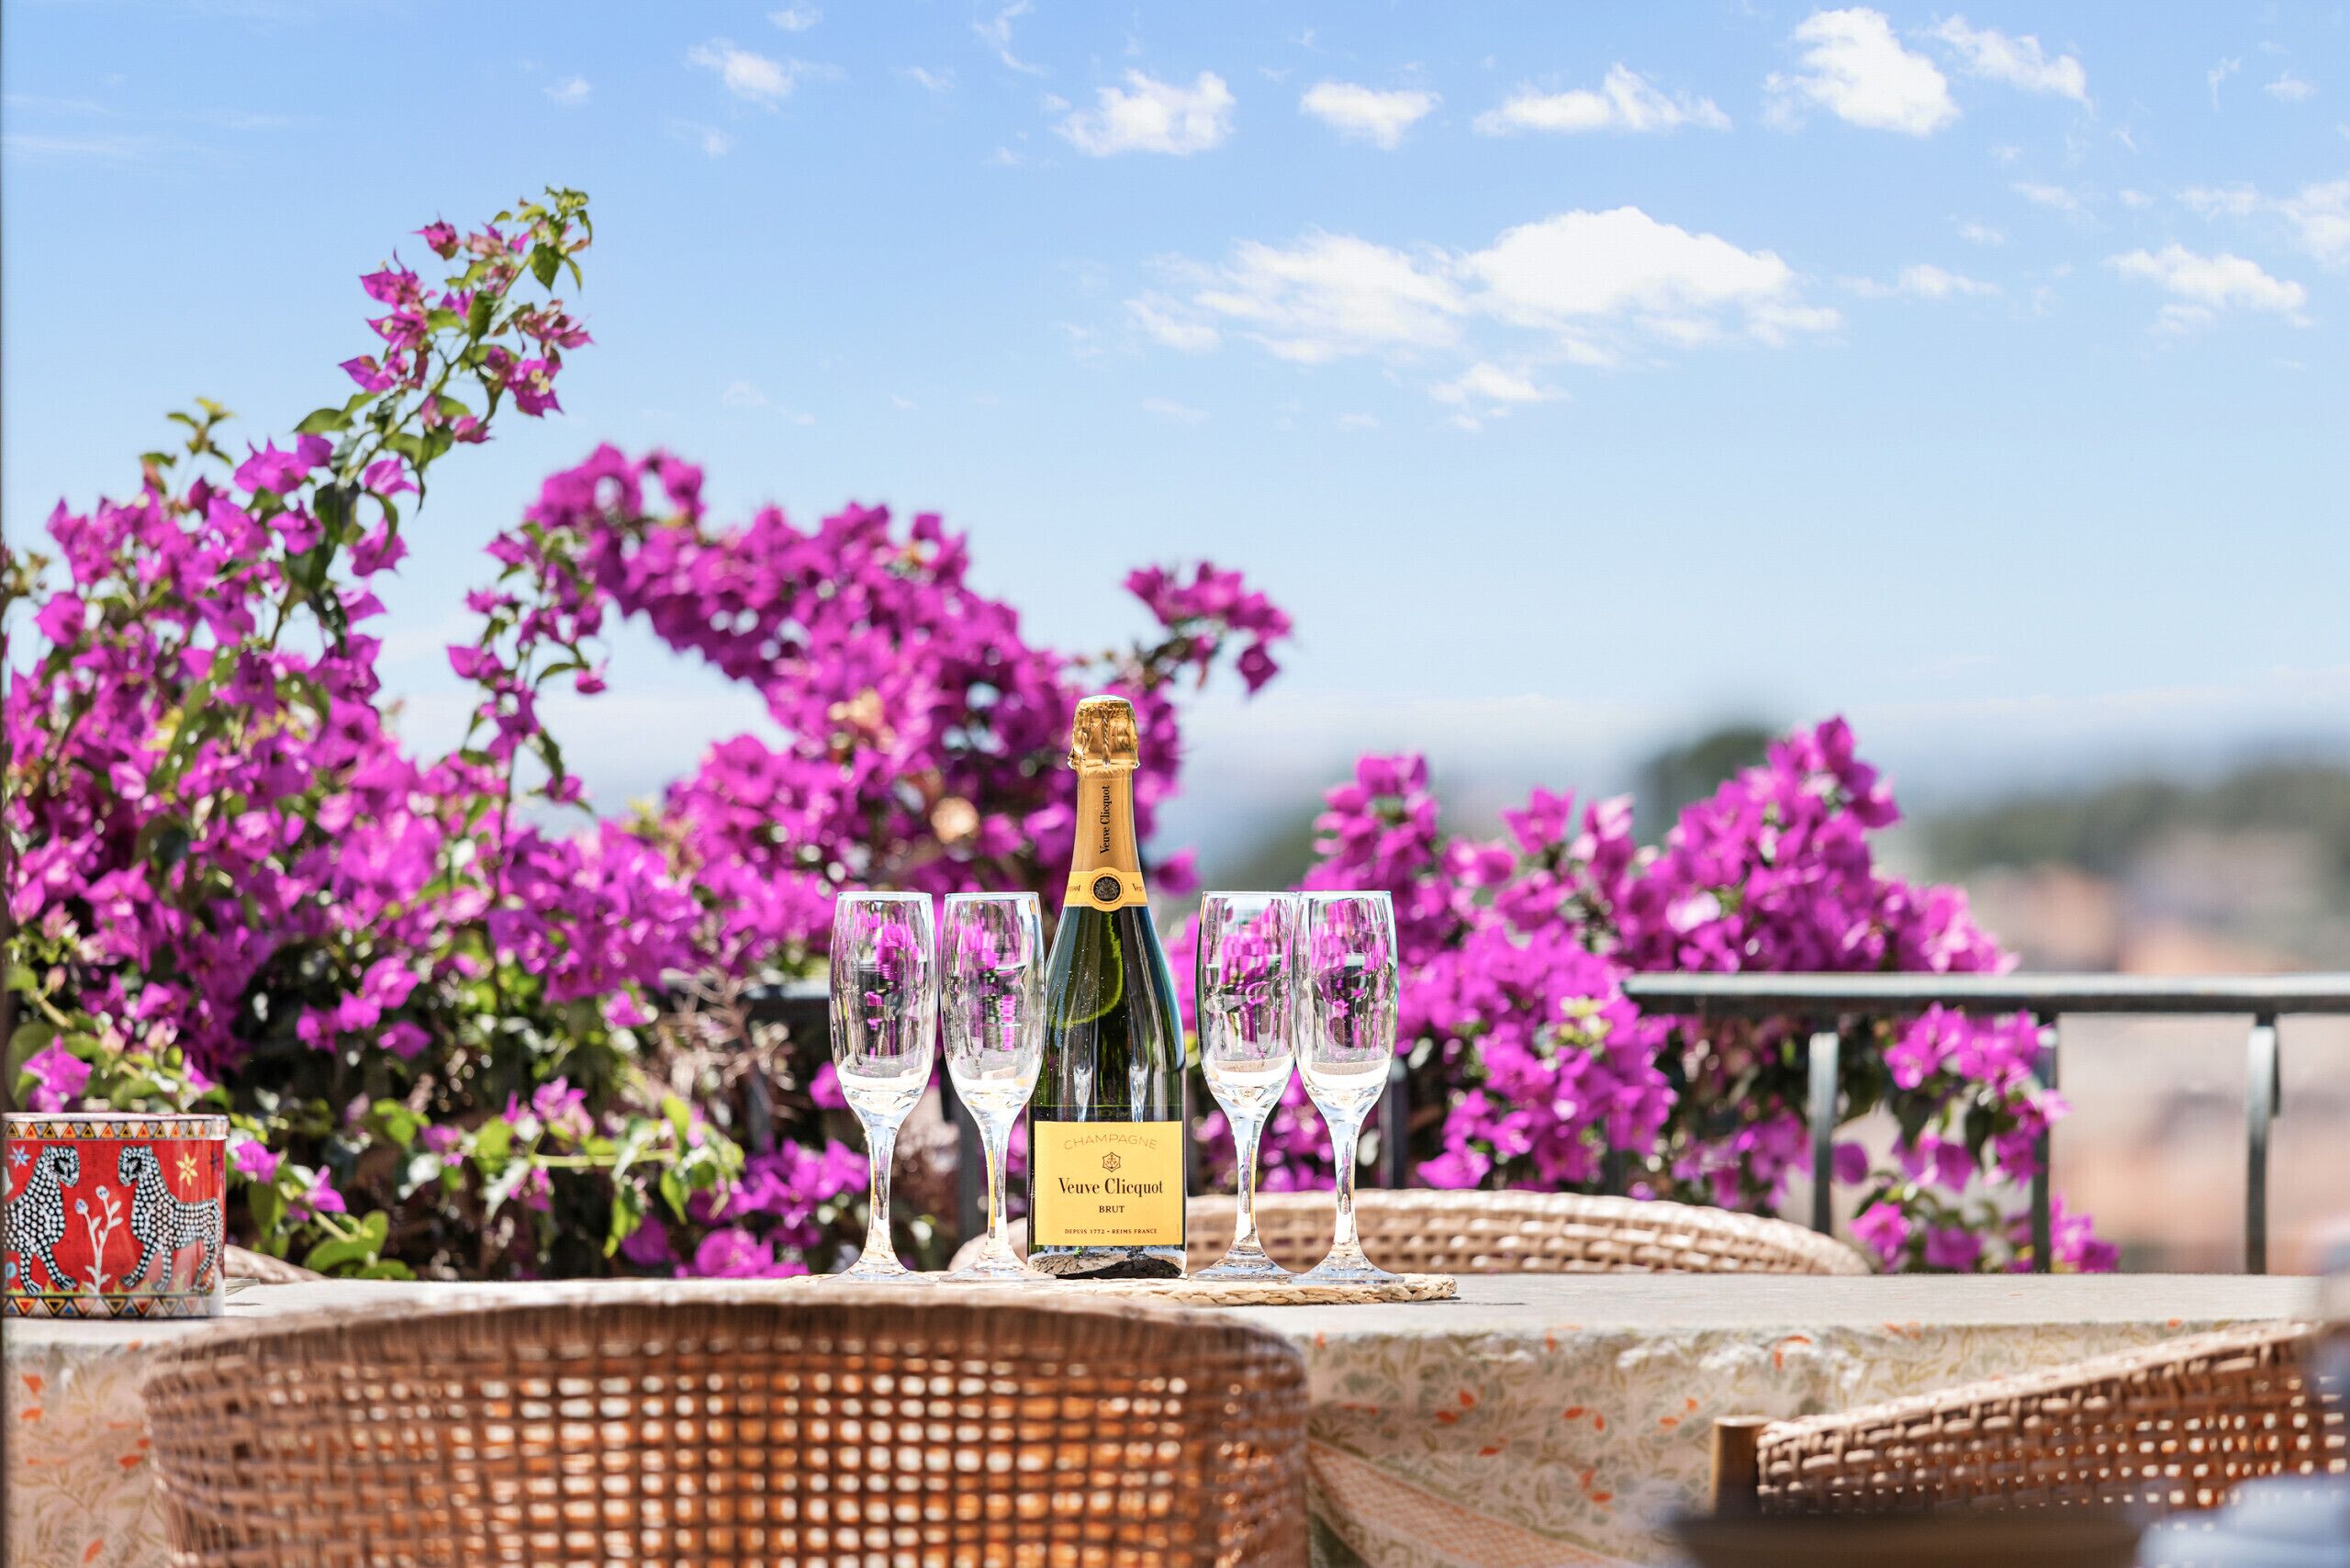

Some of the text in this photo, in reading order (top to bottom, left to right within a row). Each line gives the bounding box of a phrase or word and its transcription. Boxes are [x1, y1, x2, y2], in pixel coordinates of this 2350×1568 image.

[1100, 785, 1112, 855] Veuve Clicquot
[1064, 1134, 1158, 1150] CHAMPAGNE
[1058, 1177, 1163, 1197] Veuve Clicquot
[1099, 1205, 1125, 1214] BRUT
